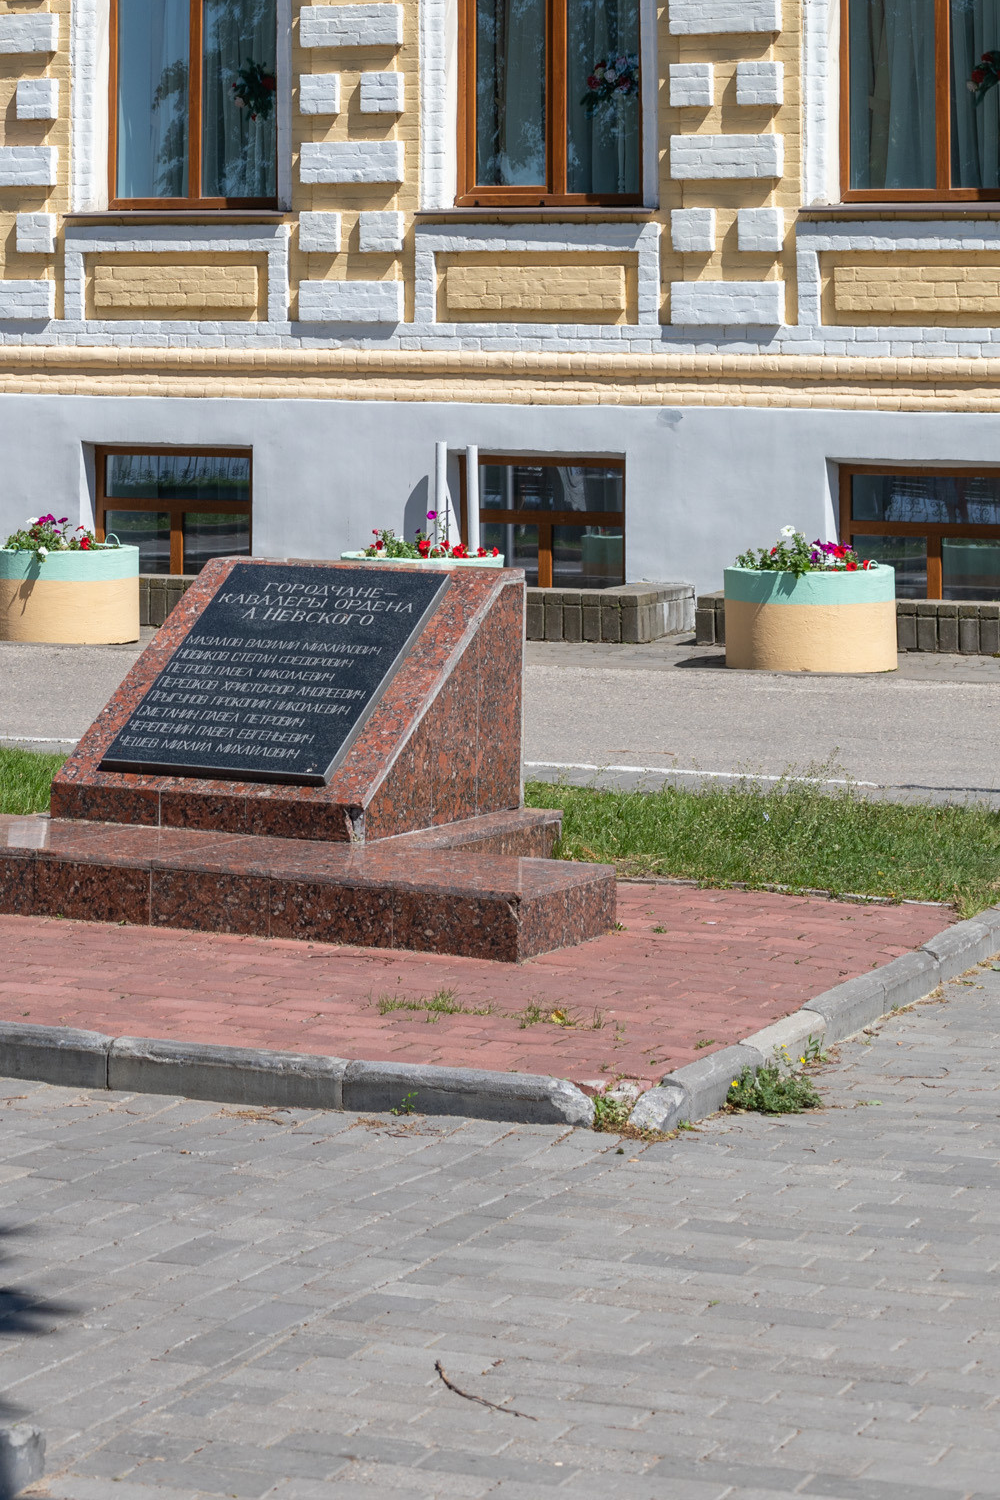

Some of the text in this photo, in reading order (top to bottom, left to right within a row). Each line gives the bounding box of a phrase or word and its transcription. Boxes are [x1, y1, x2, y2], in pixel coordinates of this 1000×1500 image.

[263, 582, 384, 599] ГОРОДЧАНЕ
[218, 593, 414, 613] КАВАЛЕРЫ ОРДЕНА
[263, 608, 375, 626] НЕВСКОГО
[186, 634, 382, 656] МАЗАЛОВ ВАСИЛИЙ МИХАЙЛОВИЧ
[176, 648, 230, 662] НОВИКОВ
[231, 652, 278, 664] СТЕПАН
[166, 662, 336, 682] ПЕТРОВ ПАВЕЛ НИКОЛАЕВИЧ
[156, 675, 218, 690] ПЕРЕДКОВ
[221, 680, 295, 695] ХРИСТОФОР
[146, 690, 352, 715] ПРЫГУНОВ ПРОКОПИЙ НИКОЛАЕВИЧ
[136, 704, 306, 728] СМЕТАНИН ПАВЕЛ ПЕТРОВИЧ
[128, 720, 315, 744] ЧЕРЕПЕНИН ПАВЕЛ ЕВГЕНЬЕВИЧ
[119, 734, 160, 748] ЧЕШЕВ
[216, 743, 301, 758] МИХАЙЛОВИЧ
